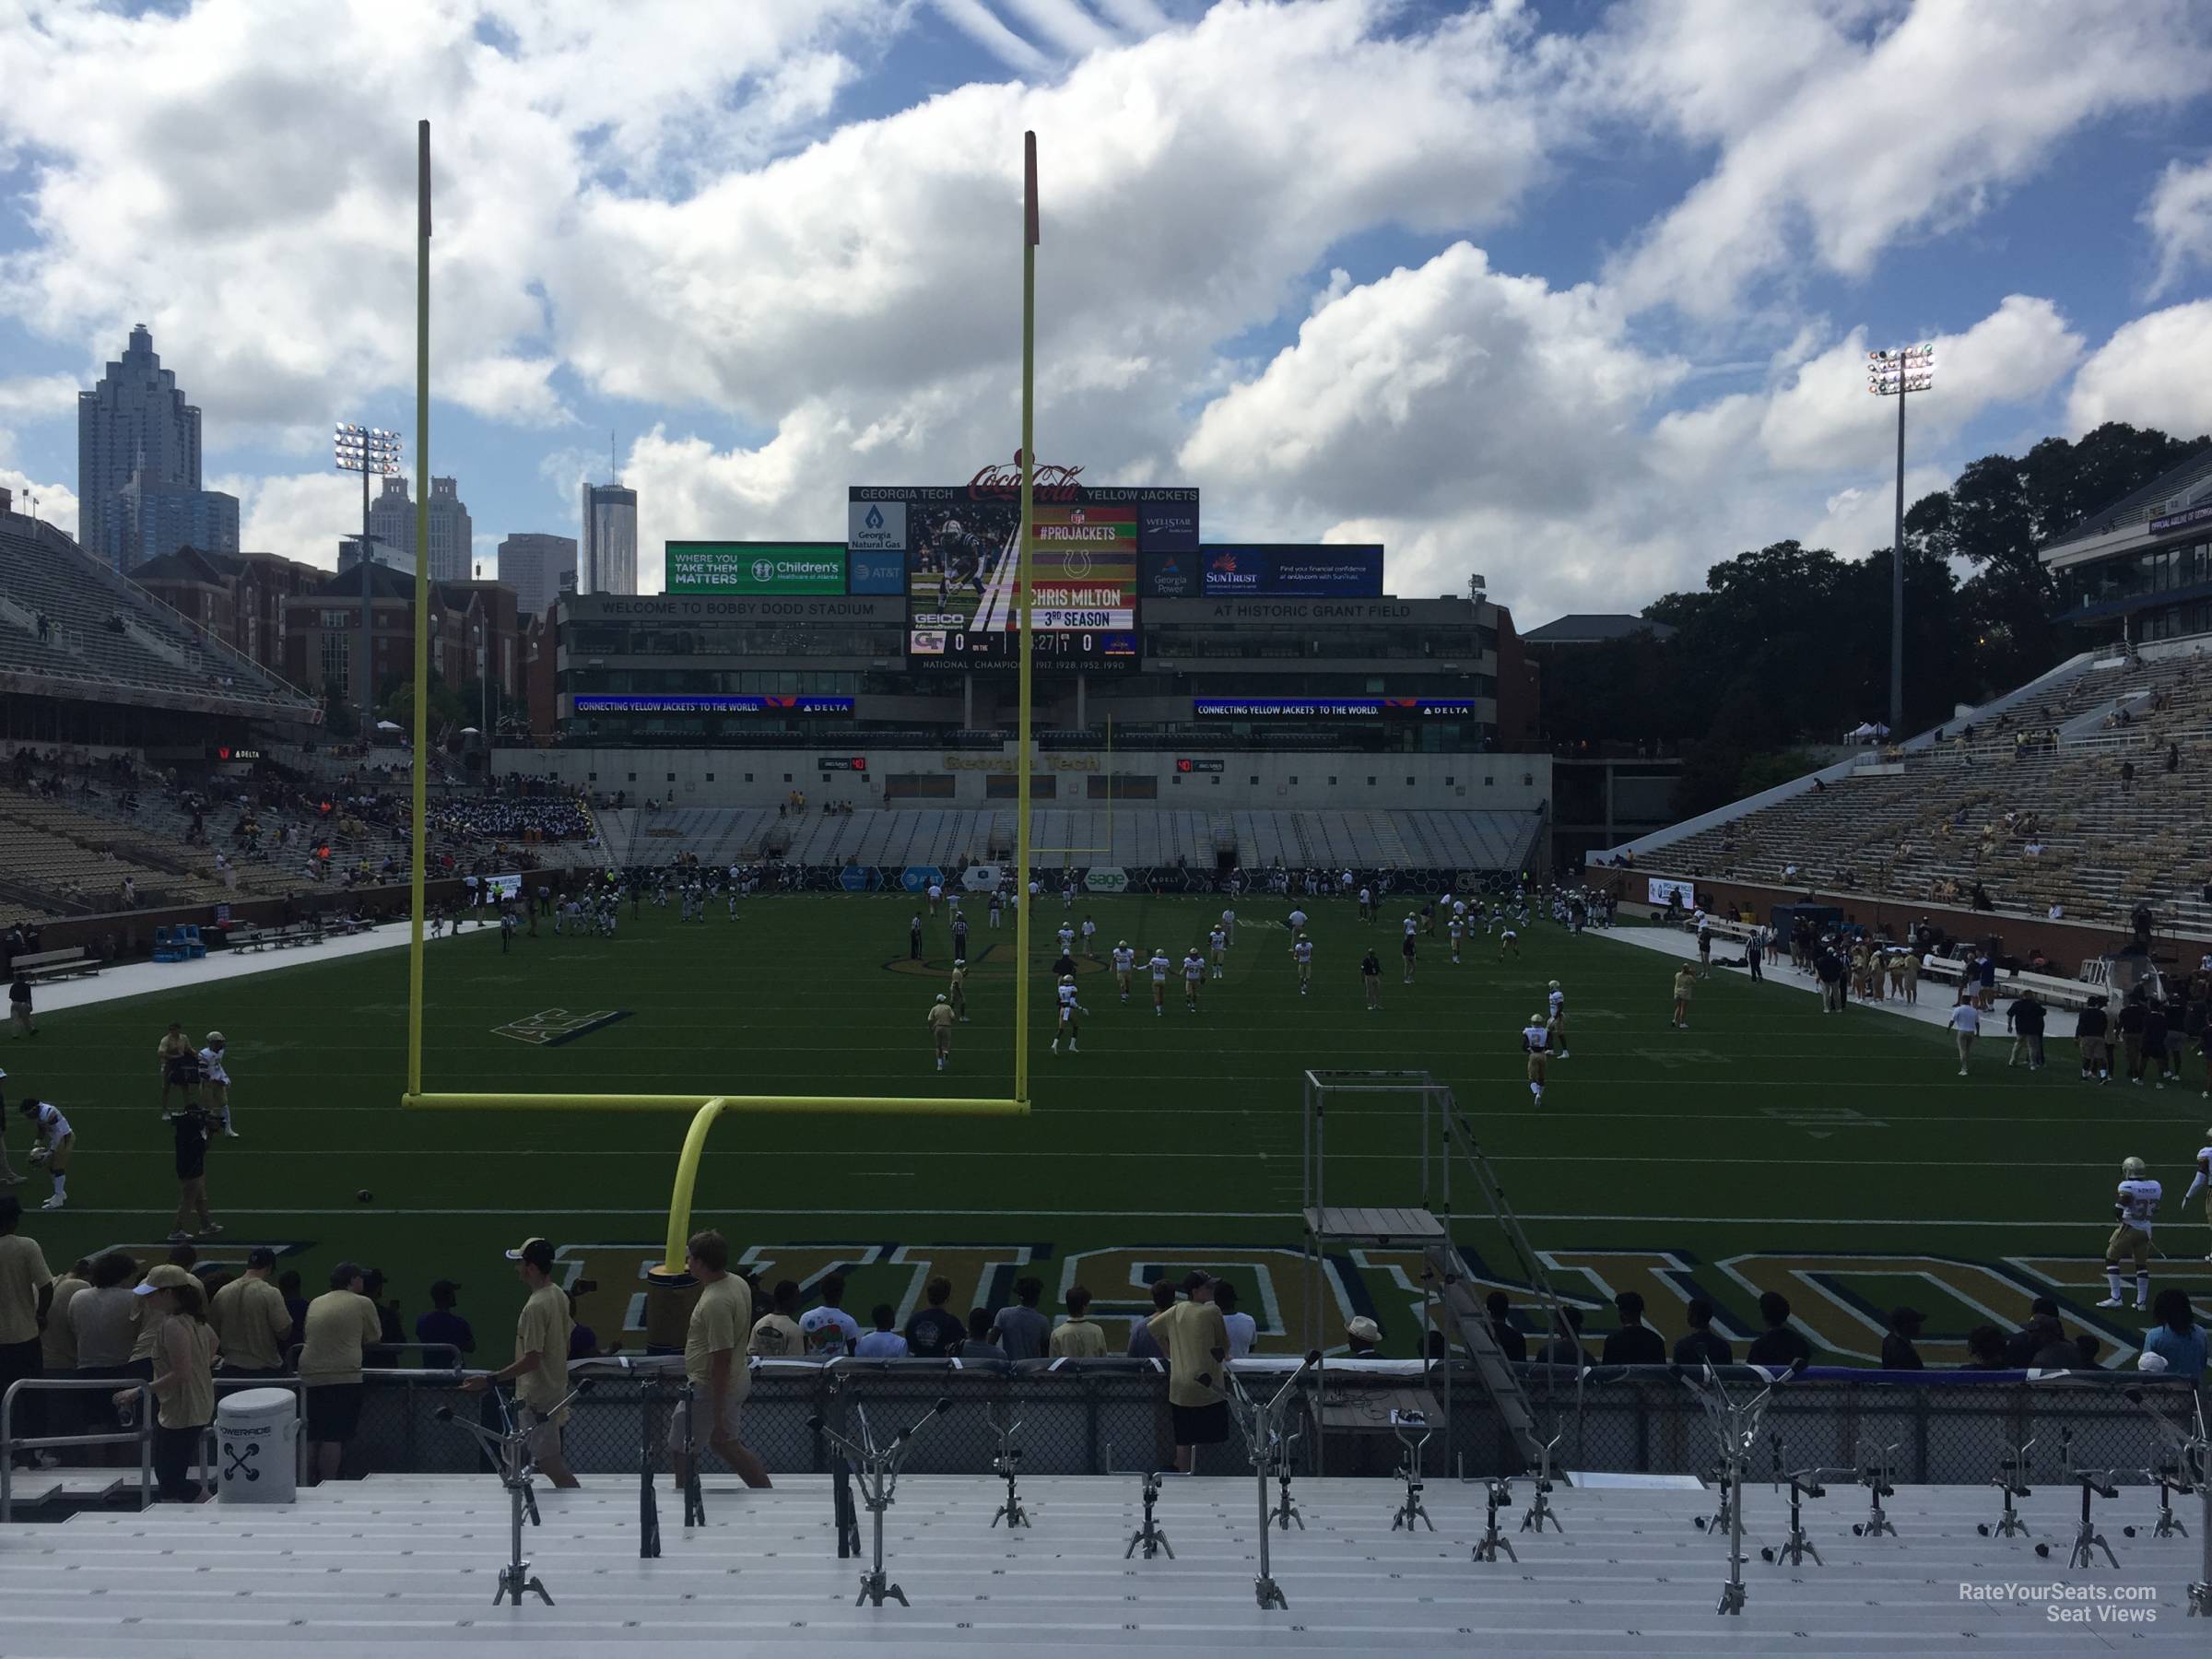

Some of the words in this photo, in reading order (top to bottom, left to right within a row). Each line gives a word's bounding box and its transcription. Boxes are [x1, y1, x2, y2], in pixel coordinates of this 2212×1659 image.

[861, 488, 917, 500] GEORGIA
[921, 488, 953, 500] TECH
[1087, 489, 1138, 500] YELLOW
[1141, 489, 1198, 501] JACKETS
[858, 531, 891, 540] Georgia
[1041, 526, 1116, 540] #PROJACKETS
[852, 540, 883, 548] Natural
[676, 554, 713, 563] WHERE
[715, 554, 737, 563] YOU
[676, 564, 704, 572] TAKE
[707, 564, 737, 573] THEM
[777, 561, 839, 573] Children's
[872, 567, 900, 578] AT&T
[676, 573, 737, 584] MATTERS
[1154, 575, 1187, 585] Georgia
[1158, 584, 1184, 594] Power
[1030, 589, 1067, 606] CHRIS
[1072, 589, 1121, 606] MILTON
[603, 603, 677, 615] WELCOME
[683, 603, 701, 615] TO
[708, 603, 756, 615] BOBBY
[761, 604, 804, 615] DODD
[808, 604, 874, 615] STADIUM
[1214, 606, 1231, 617] AT
[1238, 606, 1308, 617] HISTORIC
[1312, 606, 1361, 618] GRANT
[1369, 606, 1411, 618] FIELD
[914, 614, 964, 624] GEICO
[1044, 611, 1062, 627] 3RD
[1065, 611, 1110, 627] SEASON
[955, 633, 965, 651] 0
[1083, 634, 1092, 652] 0
[923, 661, 969, 669] NATIONAL
[974, 661, 1021, 669] CHAMPIO
[1103, 661, 1124, 669] 1990
[578, 701, 629, 712] CONNECTING
[630, 701, 660, 712] YELLOW
[700, 702, 711, 712] TO
[712, 702, 727, 712] THE
[728, 702, 759, 712] WORLD.
[1197, 705, 1248, 715] CONNECTING
[1249, 705, 1280, 715] YELLOW
[1319, 705, 1330, 715] TO
[1331, 705, 1347, 715] THE
[1347, 705, 1380, 715] WORLD.
[241, 750, 260, 759] DELTA
[1045, 755, 1100, 771] Tech
[1088, 874, 1124, 888] sage
